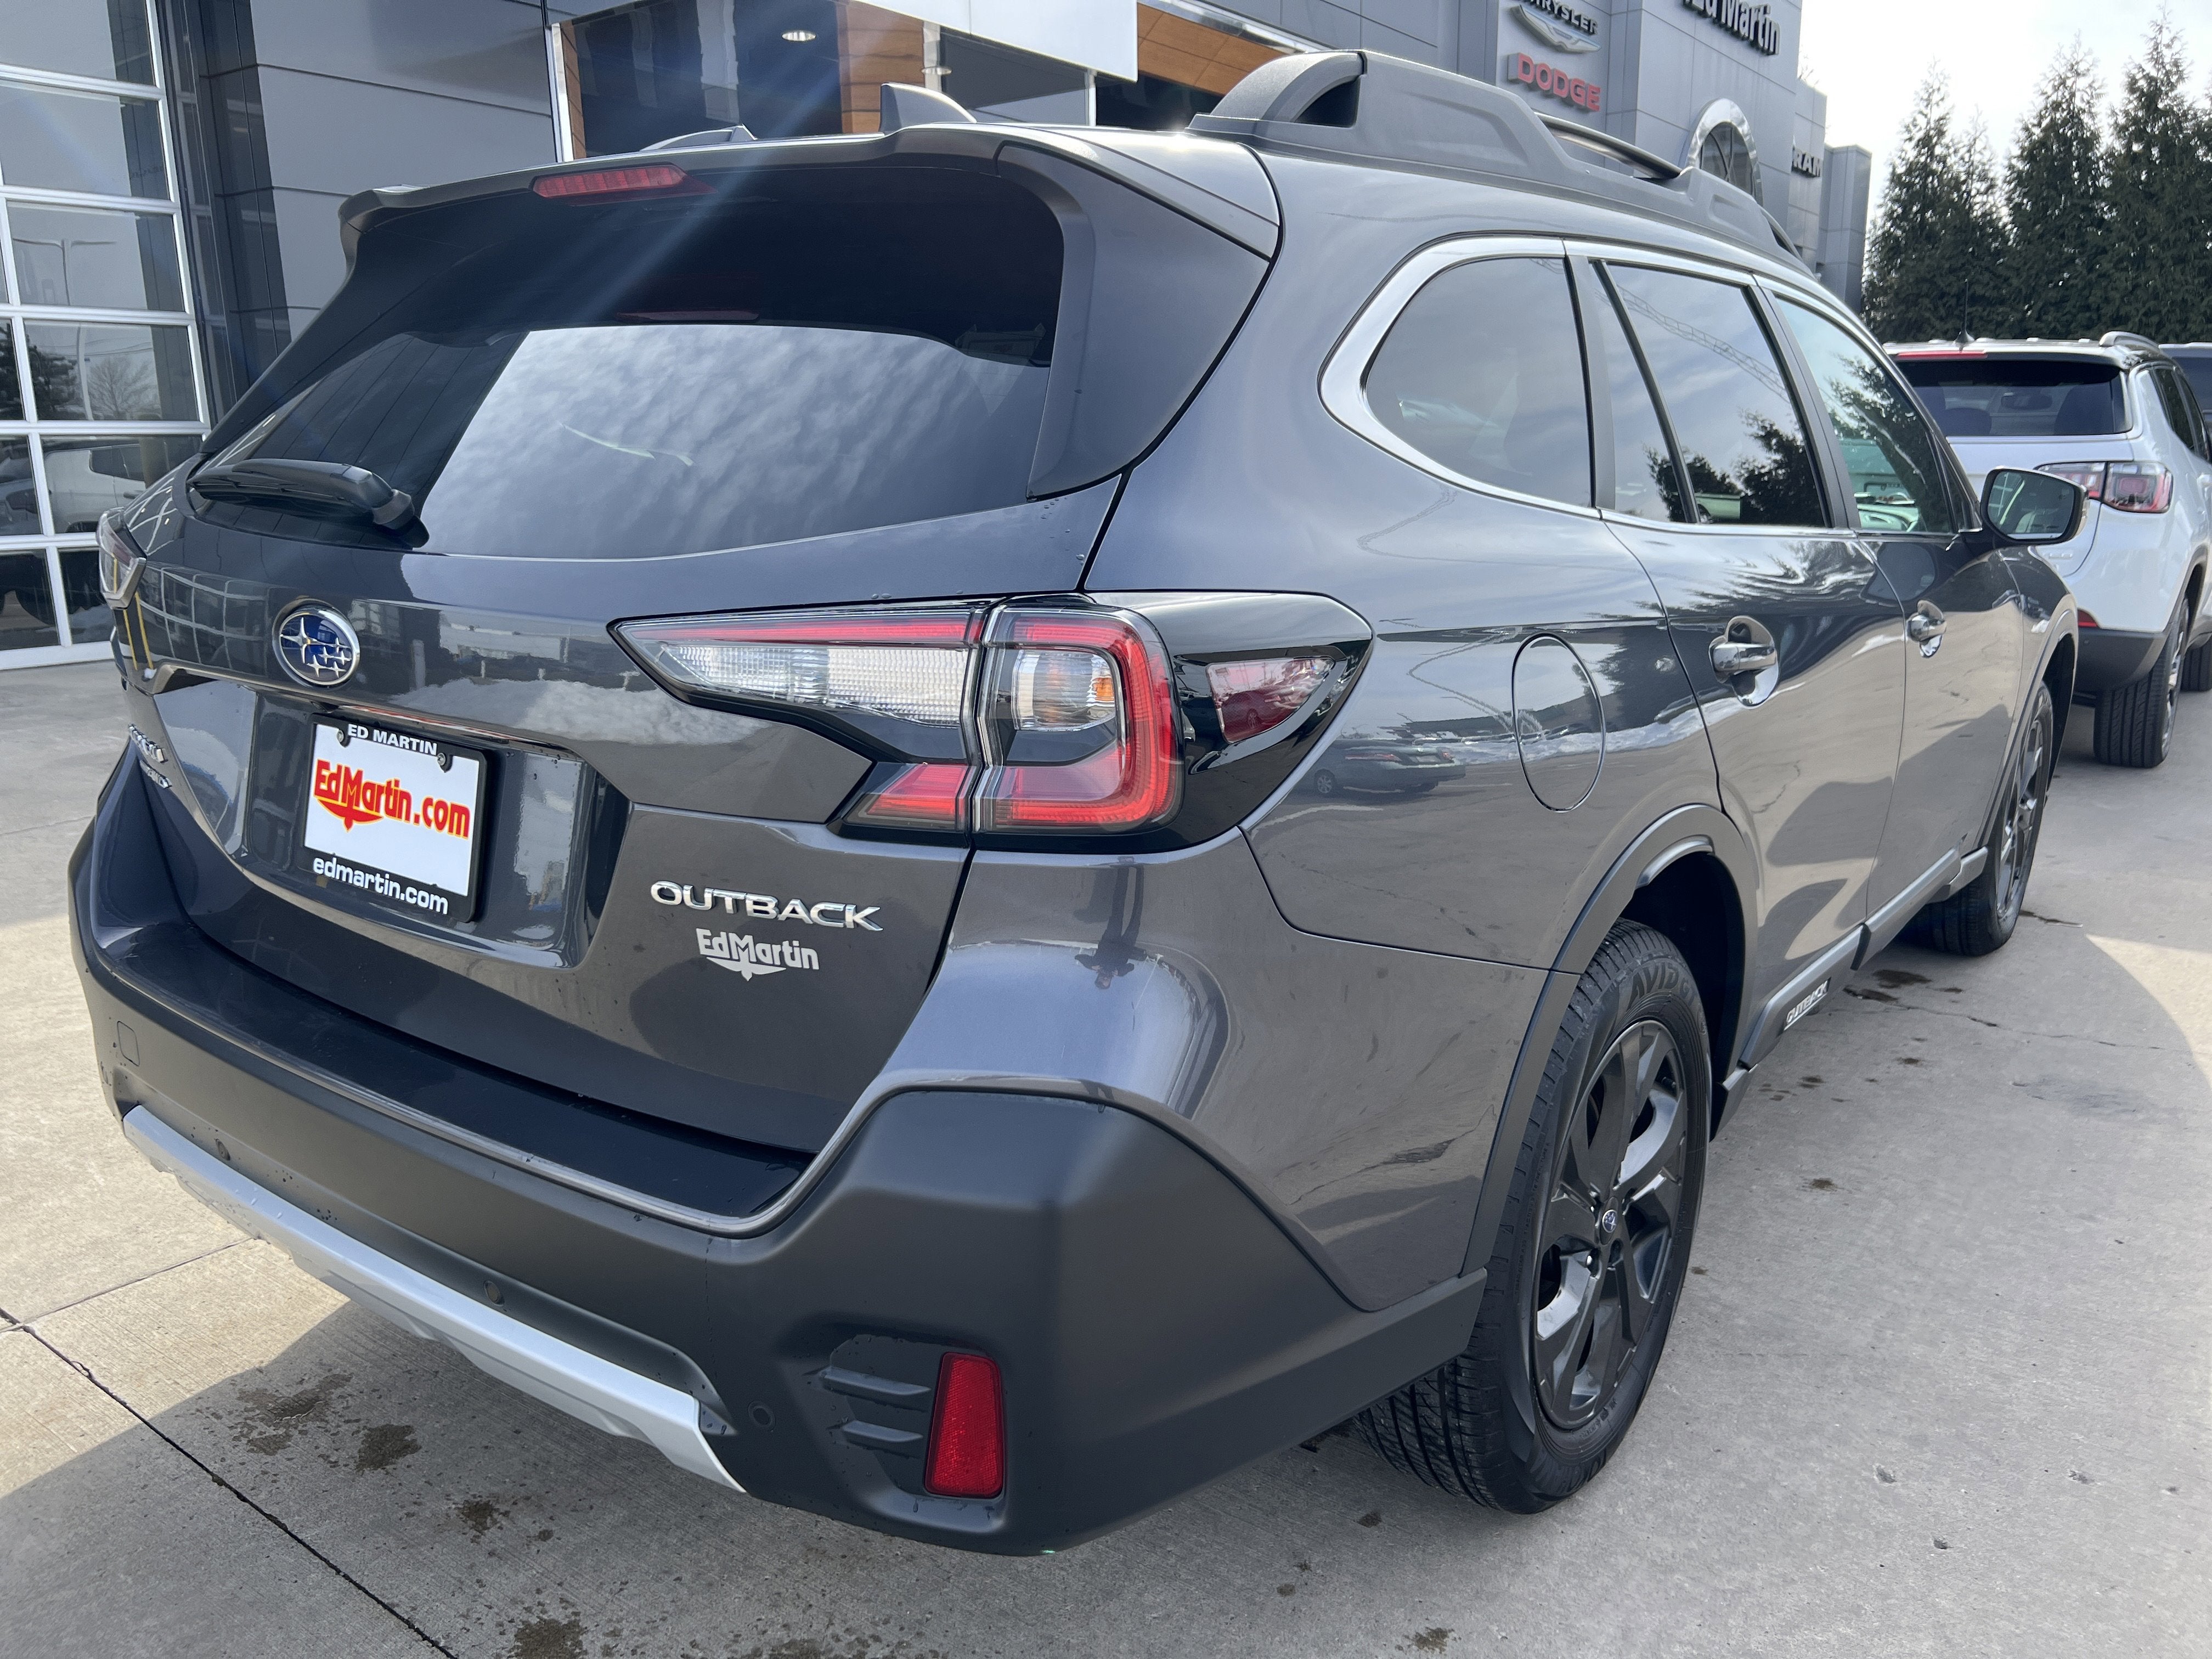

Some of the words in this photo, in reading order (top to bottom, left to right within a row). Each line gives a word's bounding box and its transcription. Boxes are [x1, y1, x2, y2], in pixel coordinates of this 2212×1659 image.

[1530, 0, 1598, 35] RYSLER
[1517, 52, 1601, 112] DODGE
[1793, 147, 1822, 177] RAM
[347, 724, 369, 740] ED
[373, 729, 438, 757] MARTIN
[313, 758, 471, 840] EdMartin.com
[313, 856, 449, 915] edmartin.com
[650, 880, 883, 932] OUTBACK
[695, 928, 820, 970] EdMartin
